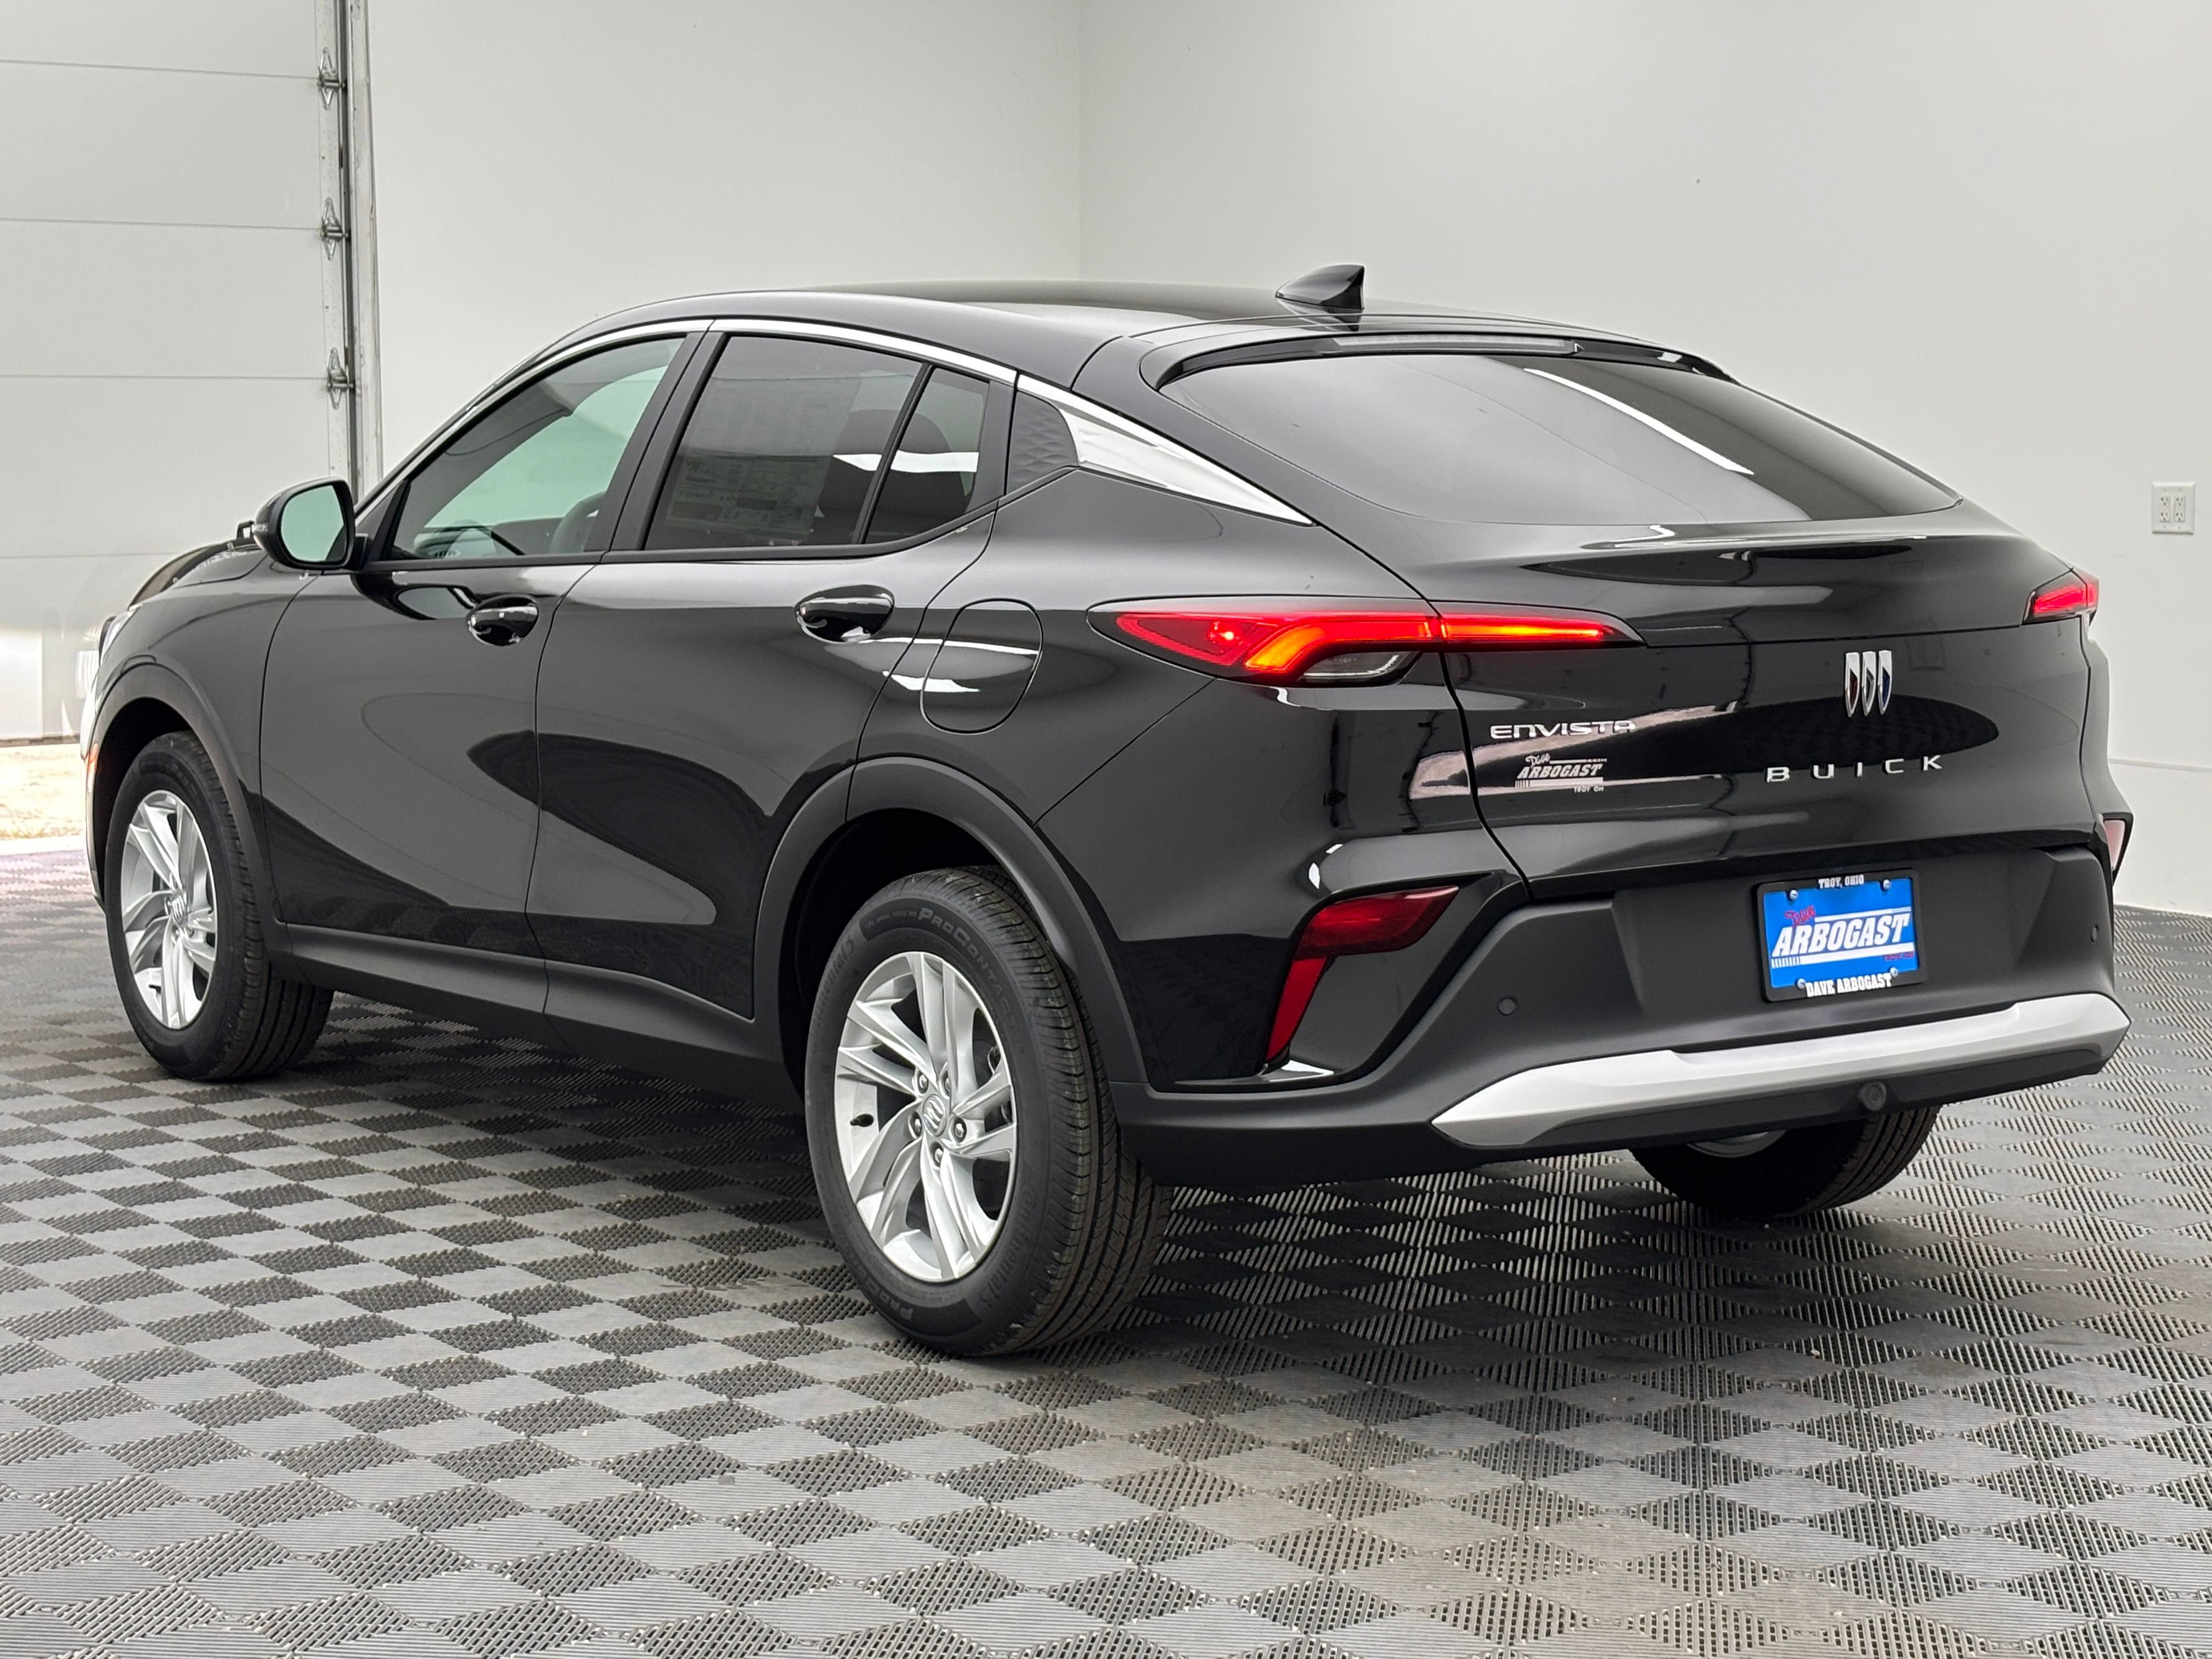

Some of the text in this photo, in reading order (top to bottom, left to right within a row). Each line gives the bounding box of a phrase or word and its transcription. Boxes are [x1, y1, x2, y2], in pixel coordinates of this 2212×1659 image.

[1490, 720, 1637, 739] ENVISTA
[1525, 753, 1550, 768] Dave
[1766, 755, 1943, 783] BUICK
[1517, 763, 1603, 779] ARBOGAST
[1819, 874, 1865, 889] TROY, OHIO
[1771, 913, 1911, 957] ARBOGAST
[1805, 972, 1892, 997] DAVE ARBOGAST
